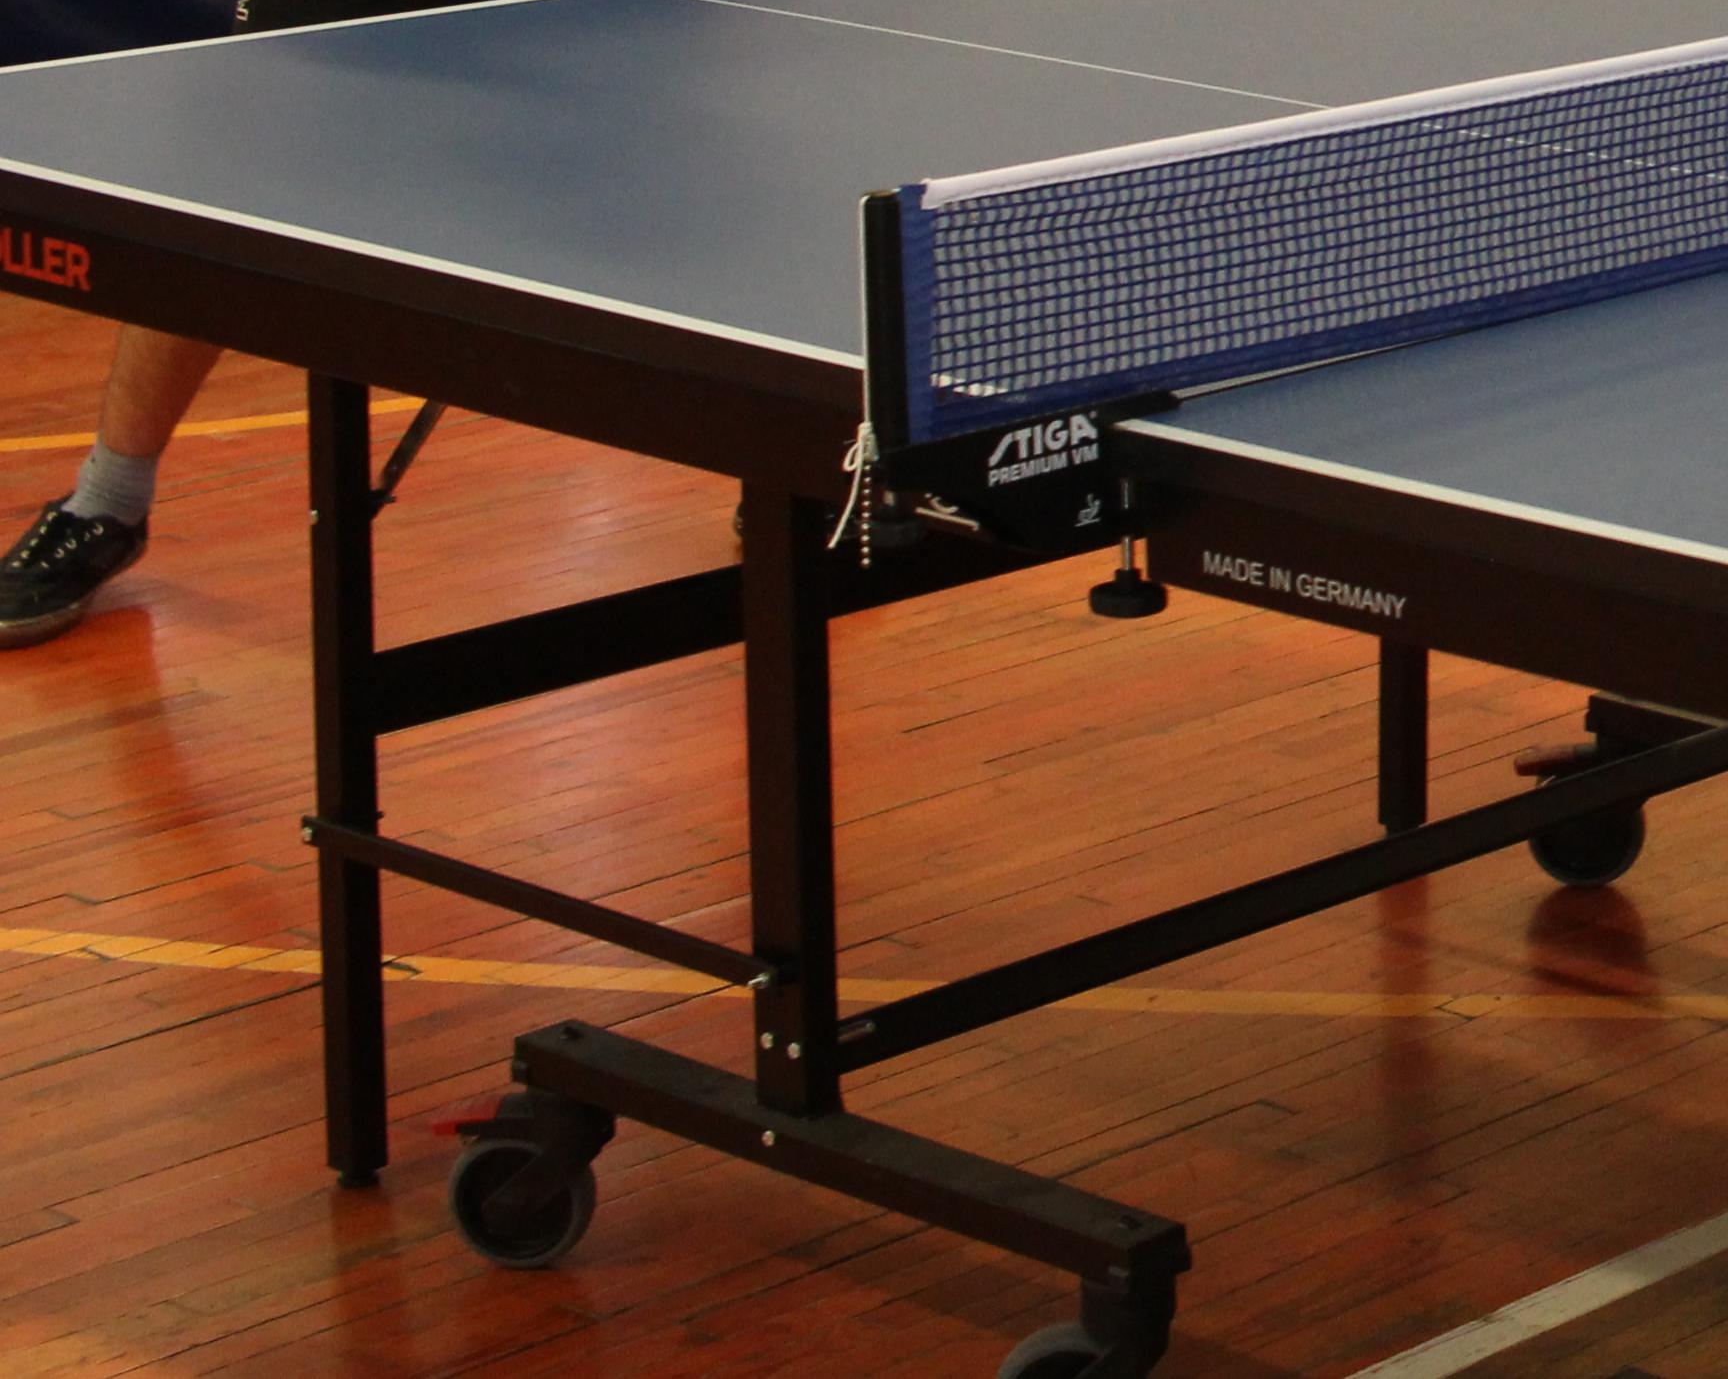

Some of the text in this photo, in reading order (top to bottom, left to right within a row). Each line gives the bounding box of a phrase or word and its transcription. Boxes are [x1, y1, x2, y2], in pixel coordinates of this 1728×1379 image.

[0, 227, 91, 292] LLER
[988, 412, 1099, 468] STIGA
[988, 443, 1099, 488] PREMIUM VM
[1203, 550, 1406, 619] MADE IN GERMANY
